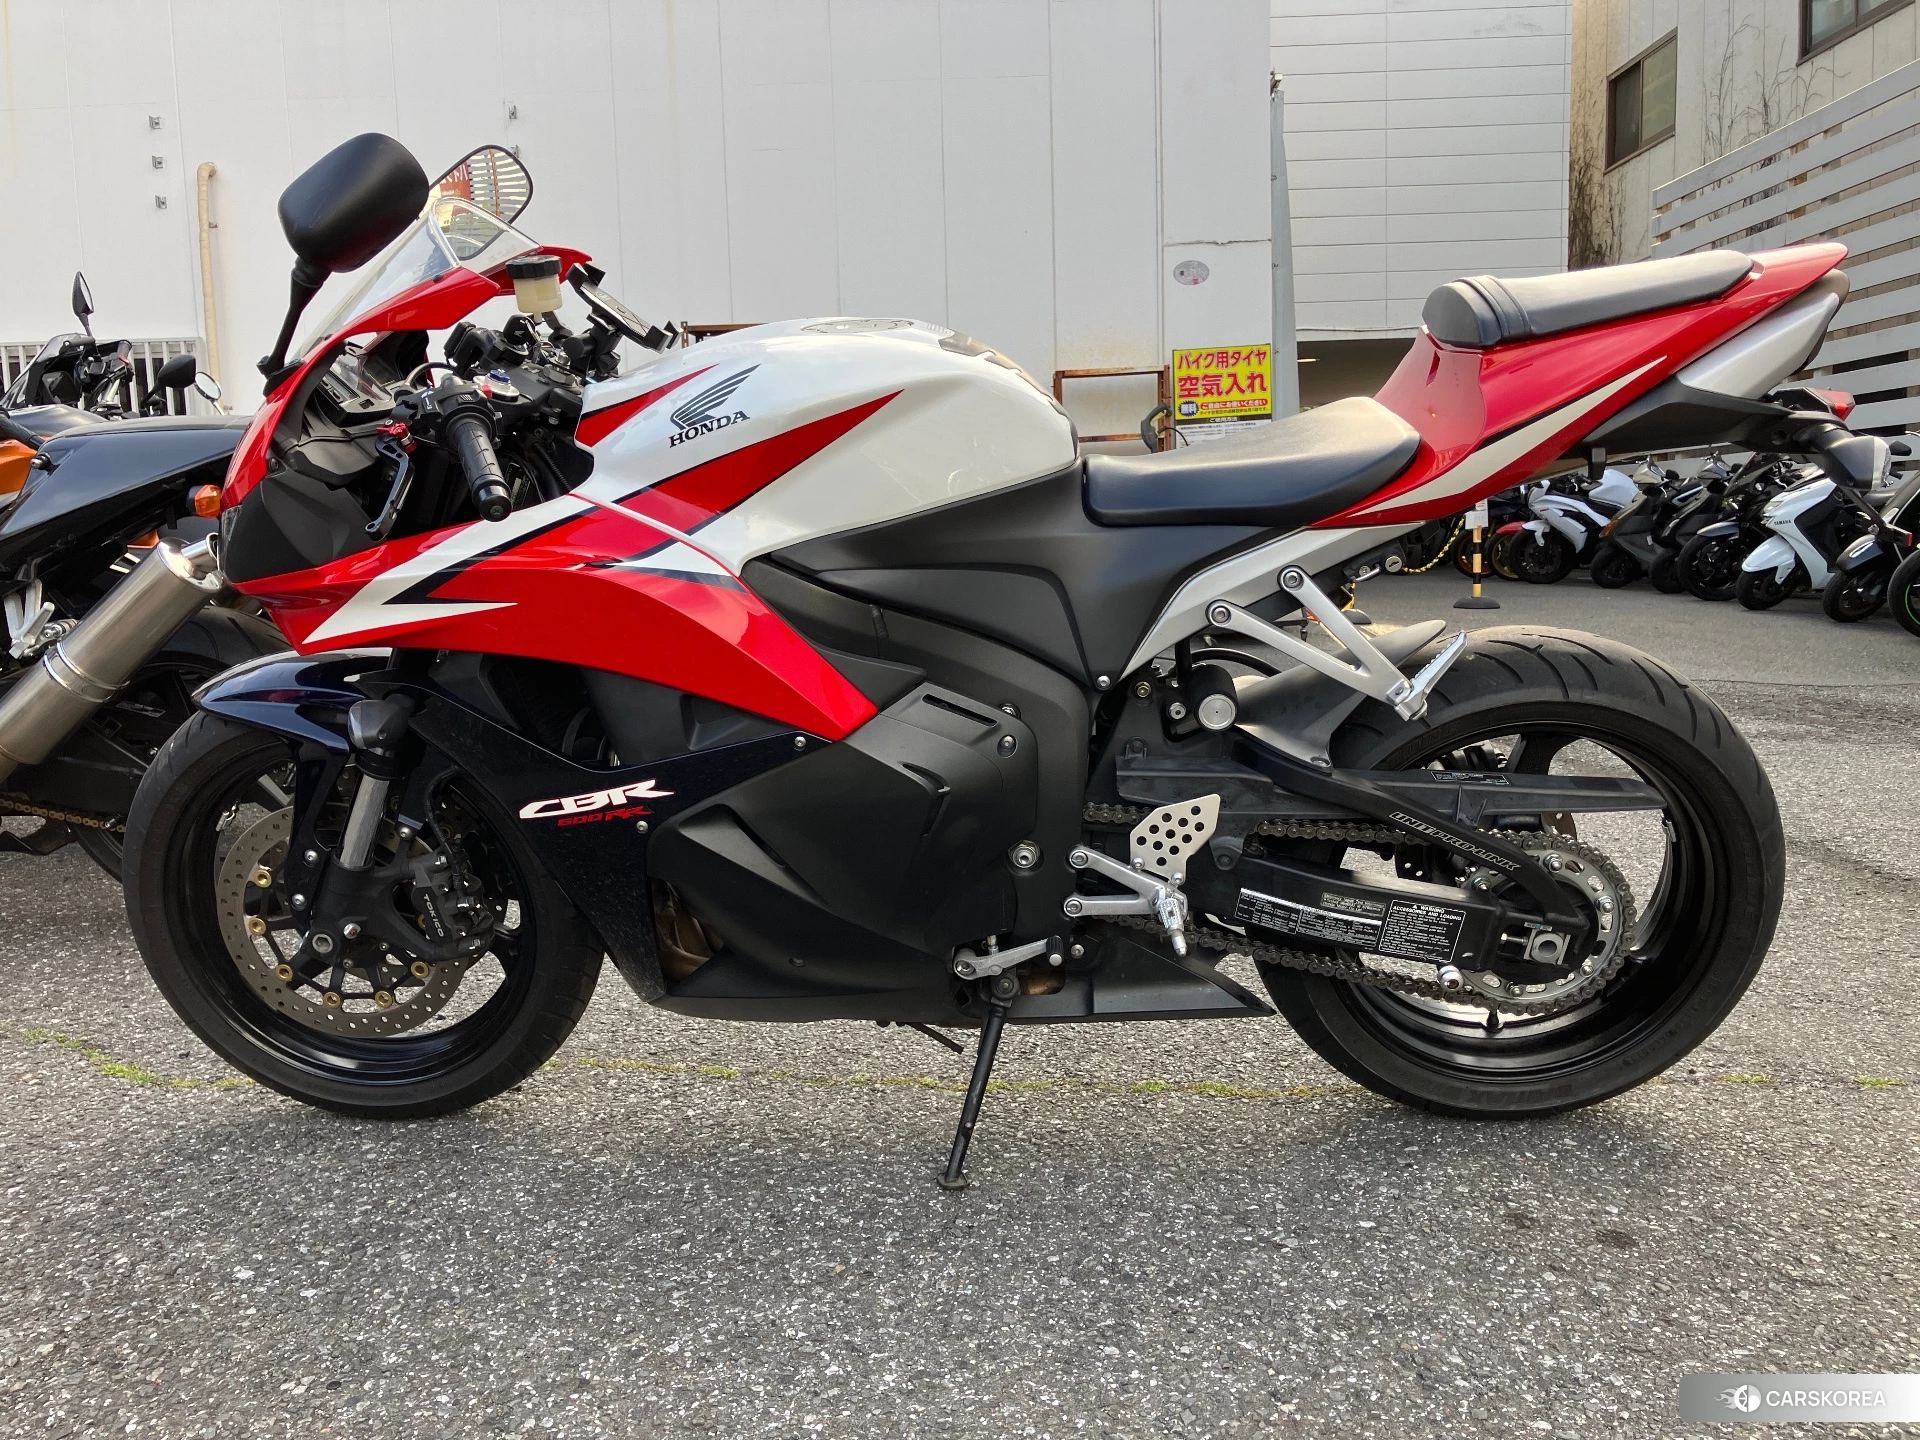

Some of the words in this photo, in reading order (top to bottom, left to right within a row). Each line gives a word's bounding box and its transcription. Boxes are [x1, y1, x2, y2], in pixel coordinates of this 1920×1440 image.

[1178, 349, 1267, 369] バイク用タイヤ
[1178, 372, 1267, 399] 空気入れ
[668, 410, 750, 448] HONDA
[519, 779, 675, 819] CBR
[423, 893, 445, 937] TOKICO
